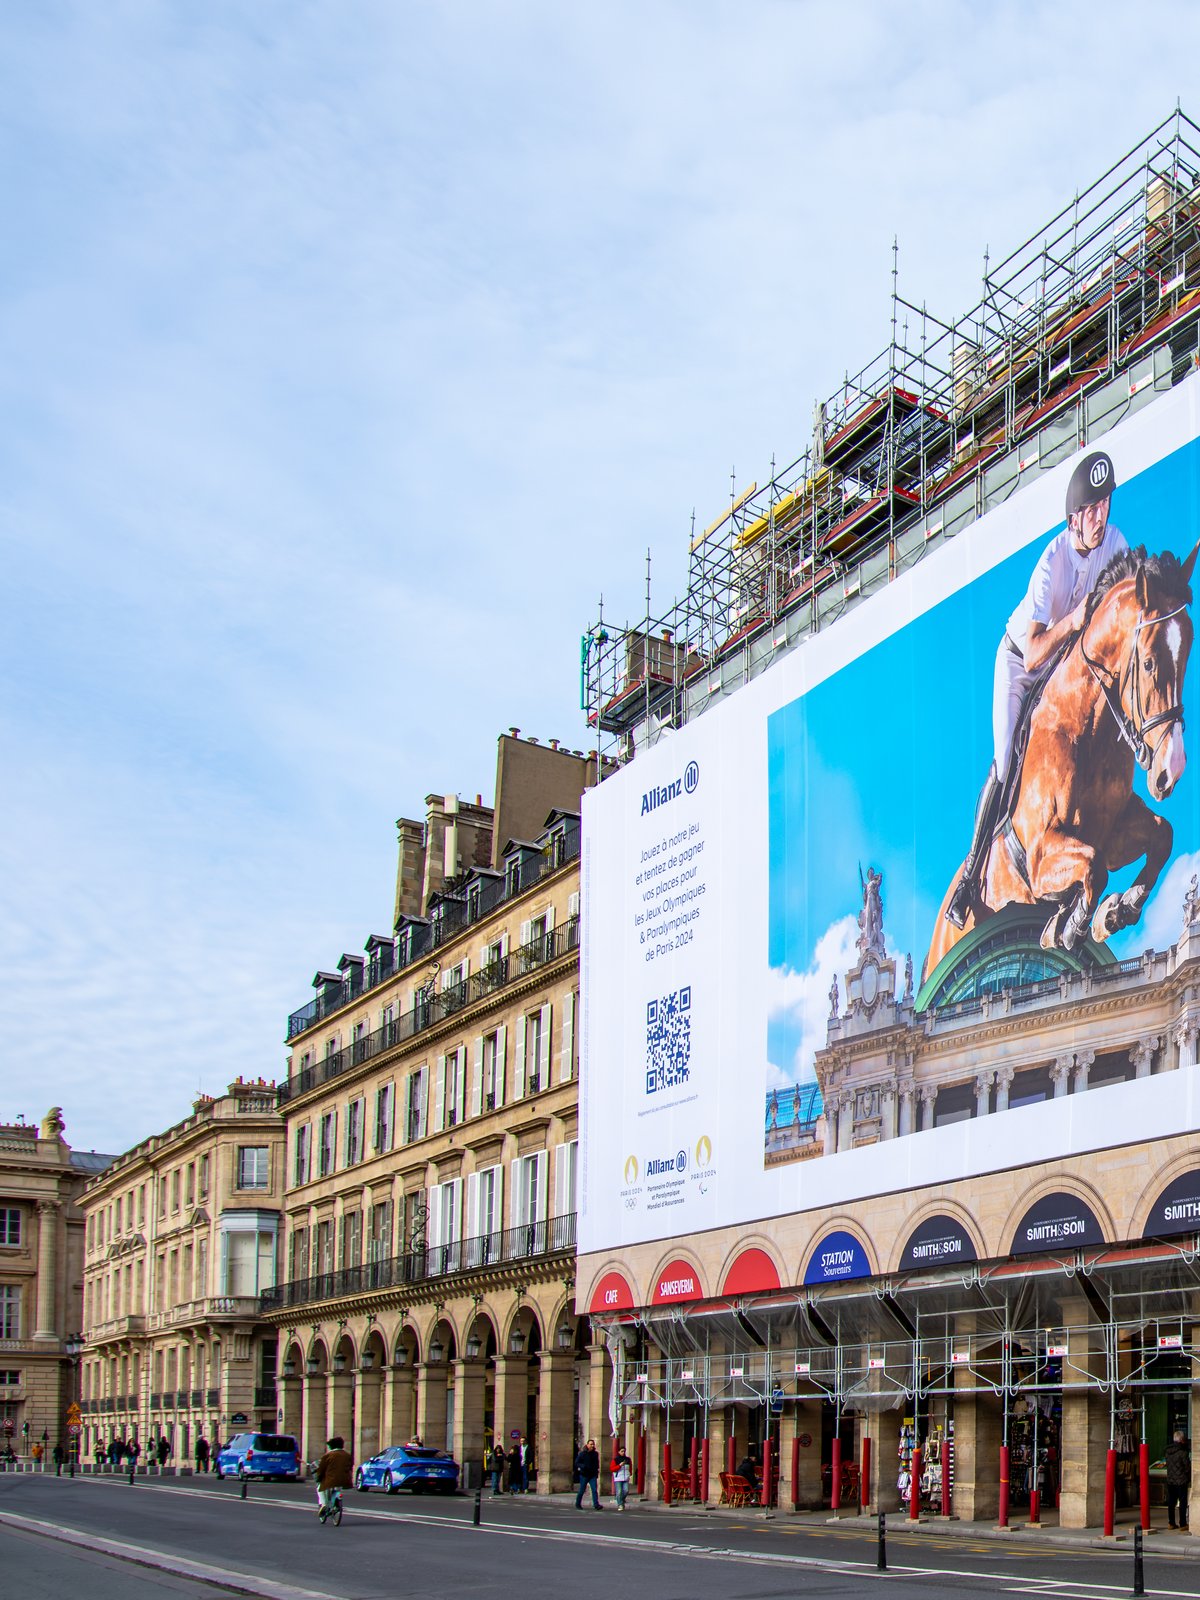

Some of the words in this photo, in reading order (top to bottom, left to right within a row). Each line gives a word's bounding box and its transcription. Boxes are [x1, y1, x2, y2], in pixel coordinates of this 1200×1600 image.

[641, 778, 682, 816] Allianz
[641, 841, 661, 864] Jouez
[661, 837, 668, 851] à
[668, 830, 688, 849] notre
[688, 821, 700, 842] jeu
[635, 872, 644, 886] et
[644, 861, 667, 882] tentez
[667, 853, 678, 869] de
[678, 840, 706, 867] gagner
[642, 886, 655, 902] vos
[656, 875, 679, 899] places
[680, 865, 698, 888] pour
[634, 909, 645, 928] les
[645, 904, 662, 922] Jeux
[662, 882, 706, 913] Olympiques
[639, 931, 646, 945] &
[646, 907, 700, 939] Paralympiques
[645, 946, 655, 962] de
[656, 938, 674, 958] Paris
[675, 928, 694, 948] 2024
[647, 1158, 675, 1177] Allianz
[1026, 1220, 1085, 1241] SMITH&SON
[821, 1250, 854, 1267] STATION
[912, 1239, 962, 1258] SMITH&SON
[660, 1278, 694, 1296] SANSEVERIA
[823, 1264, 852, 1277] Souvenirs
